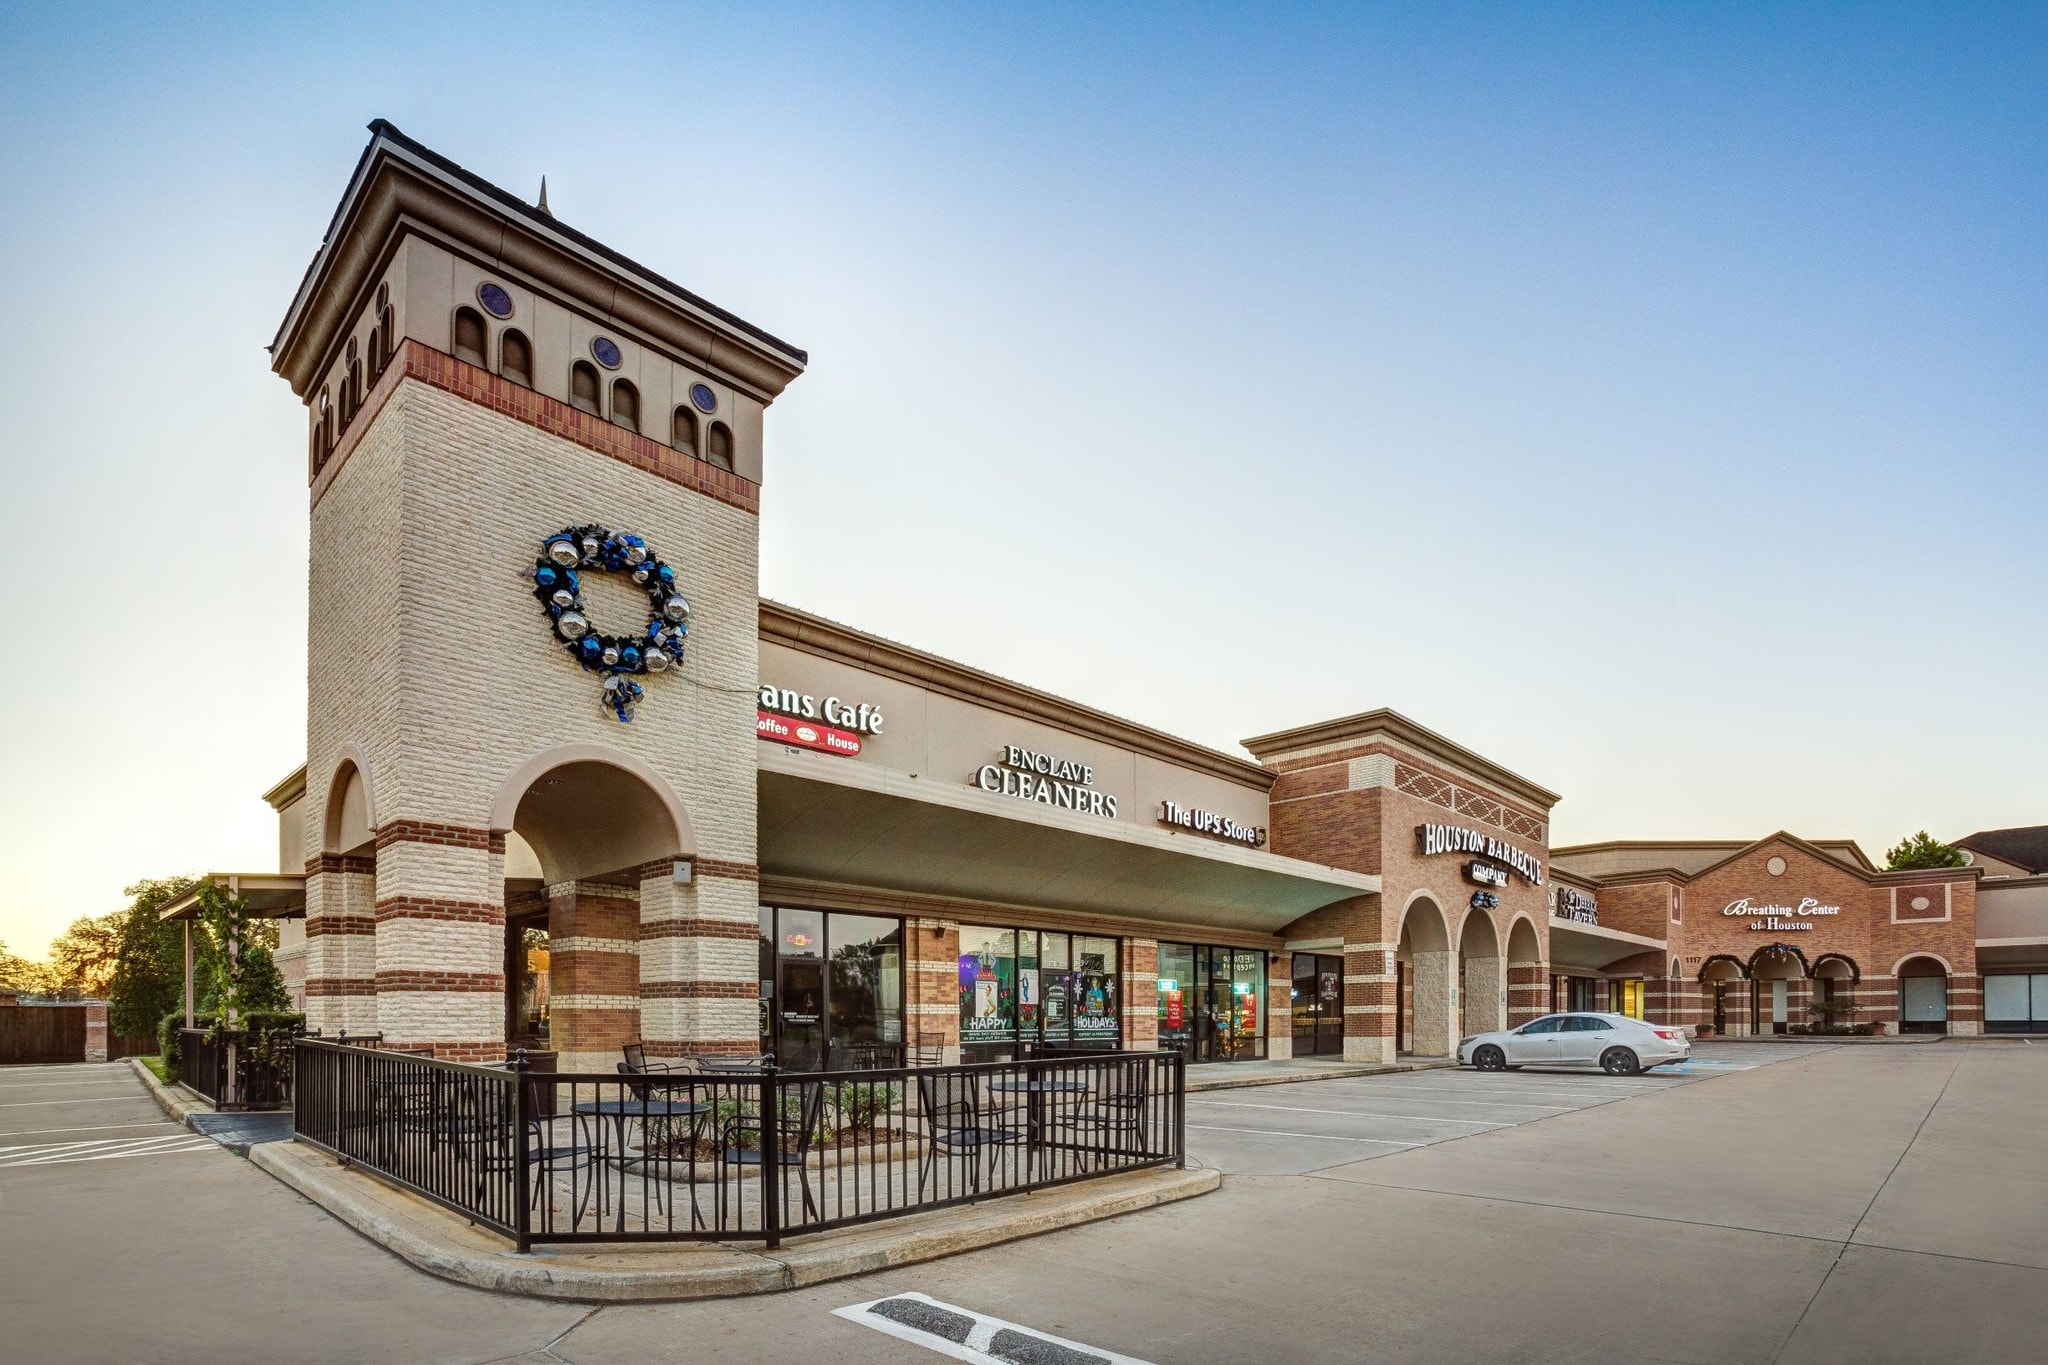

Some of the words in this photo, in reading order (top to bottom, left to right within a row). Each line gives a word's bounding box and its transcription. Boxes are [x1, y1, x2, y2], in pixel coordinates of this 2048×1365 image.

[757, 684, 815, 718] ans
[824, 696, 884, 735] Café
[827, 733, 859, 751] House
[1008, 745, 1094, 786] ENCLAVE
[979, 765, 1118, 820] CLEANERS
[1165, 800, 1192, 827] The
[1194, 808, 1221, 834] UPS
[1223, 816, 1256, 843] Store
[1425, 823, 1486, 856] HOUSTON
[1487, 837, 1544, 886] BARBECUE
[1472, 863, 1508, 883] COMPANY
[1567, 904, 1599, 926] TAVERN
[1723, 897, 1793, 917] Breathing
[1797, 897, 1840, 916] Center
[1750, 919, 1762, 930] of
[1766, 917, 1813, 931] Houston
[1685, 956, 1702, 964] 1117
[969, 1016, 1008, 1030] HAPPY
